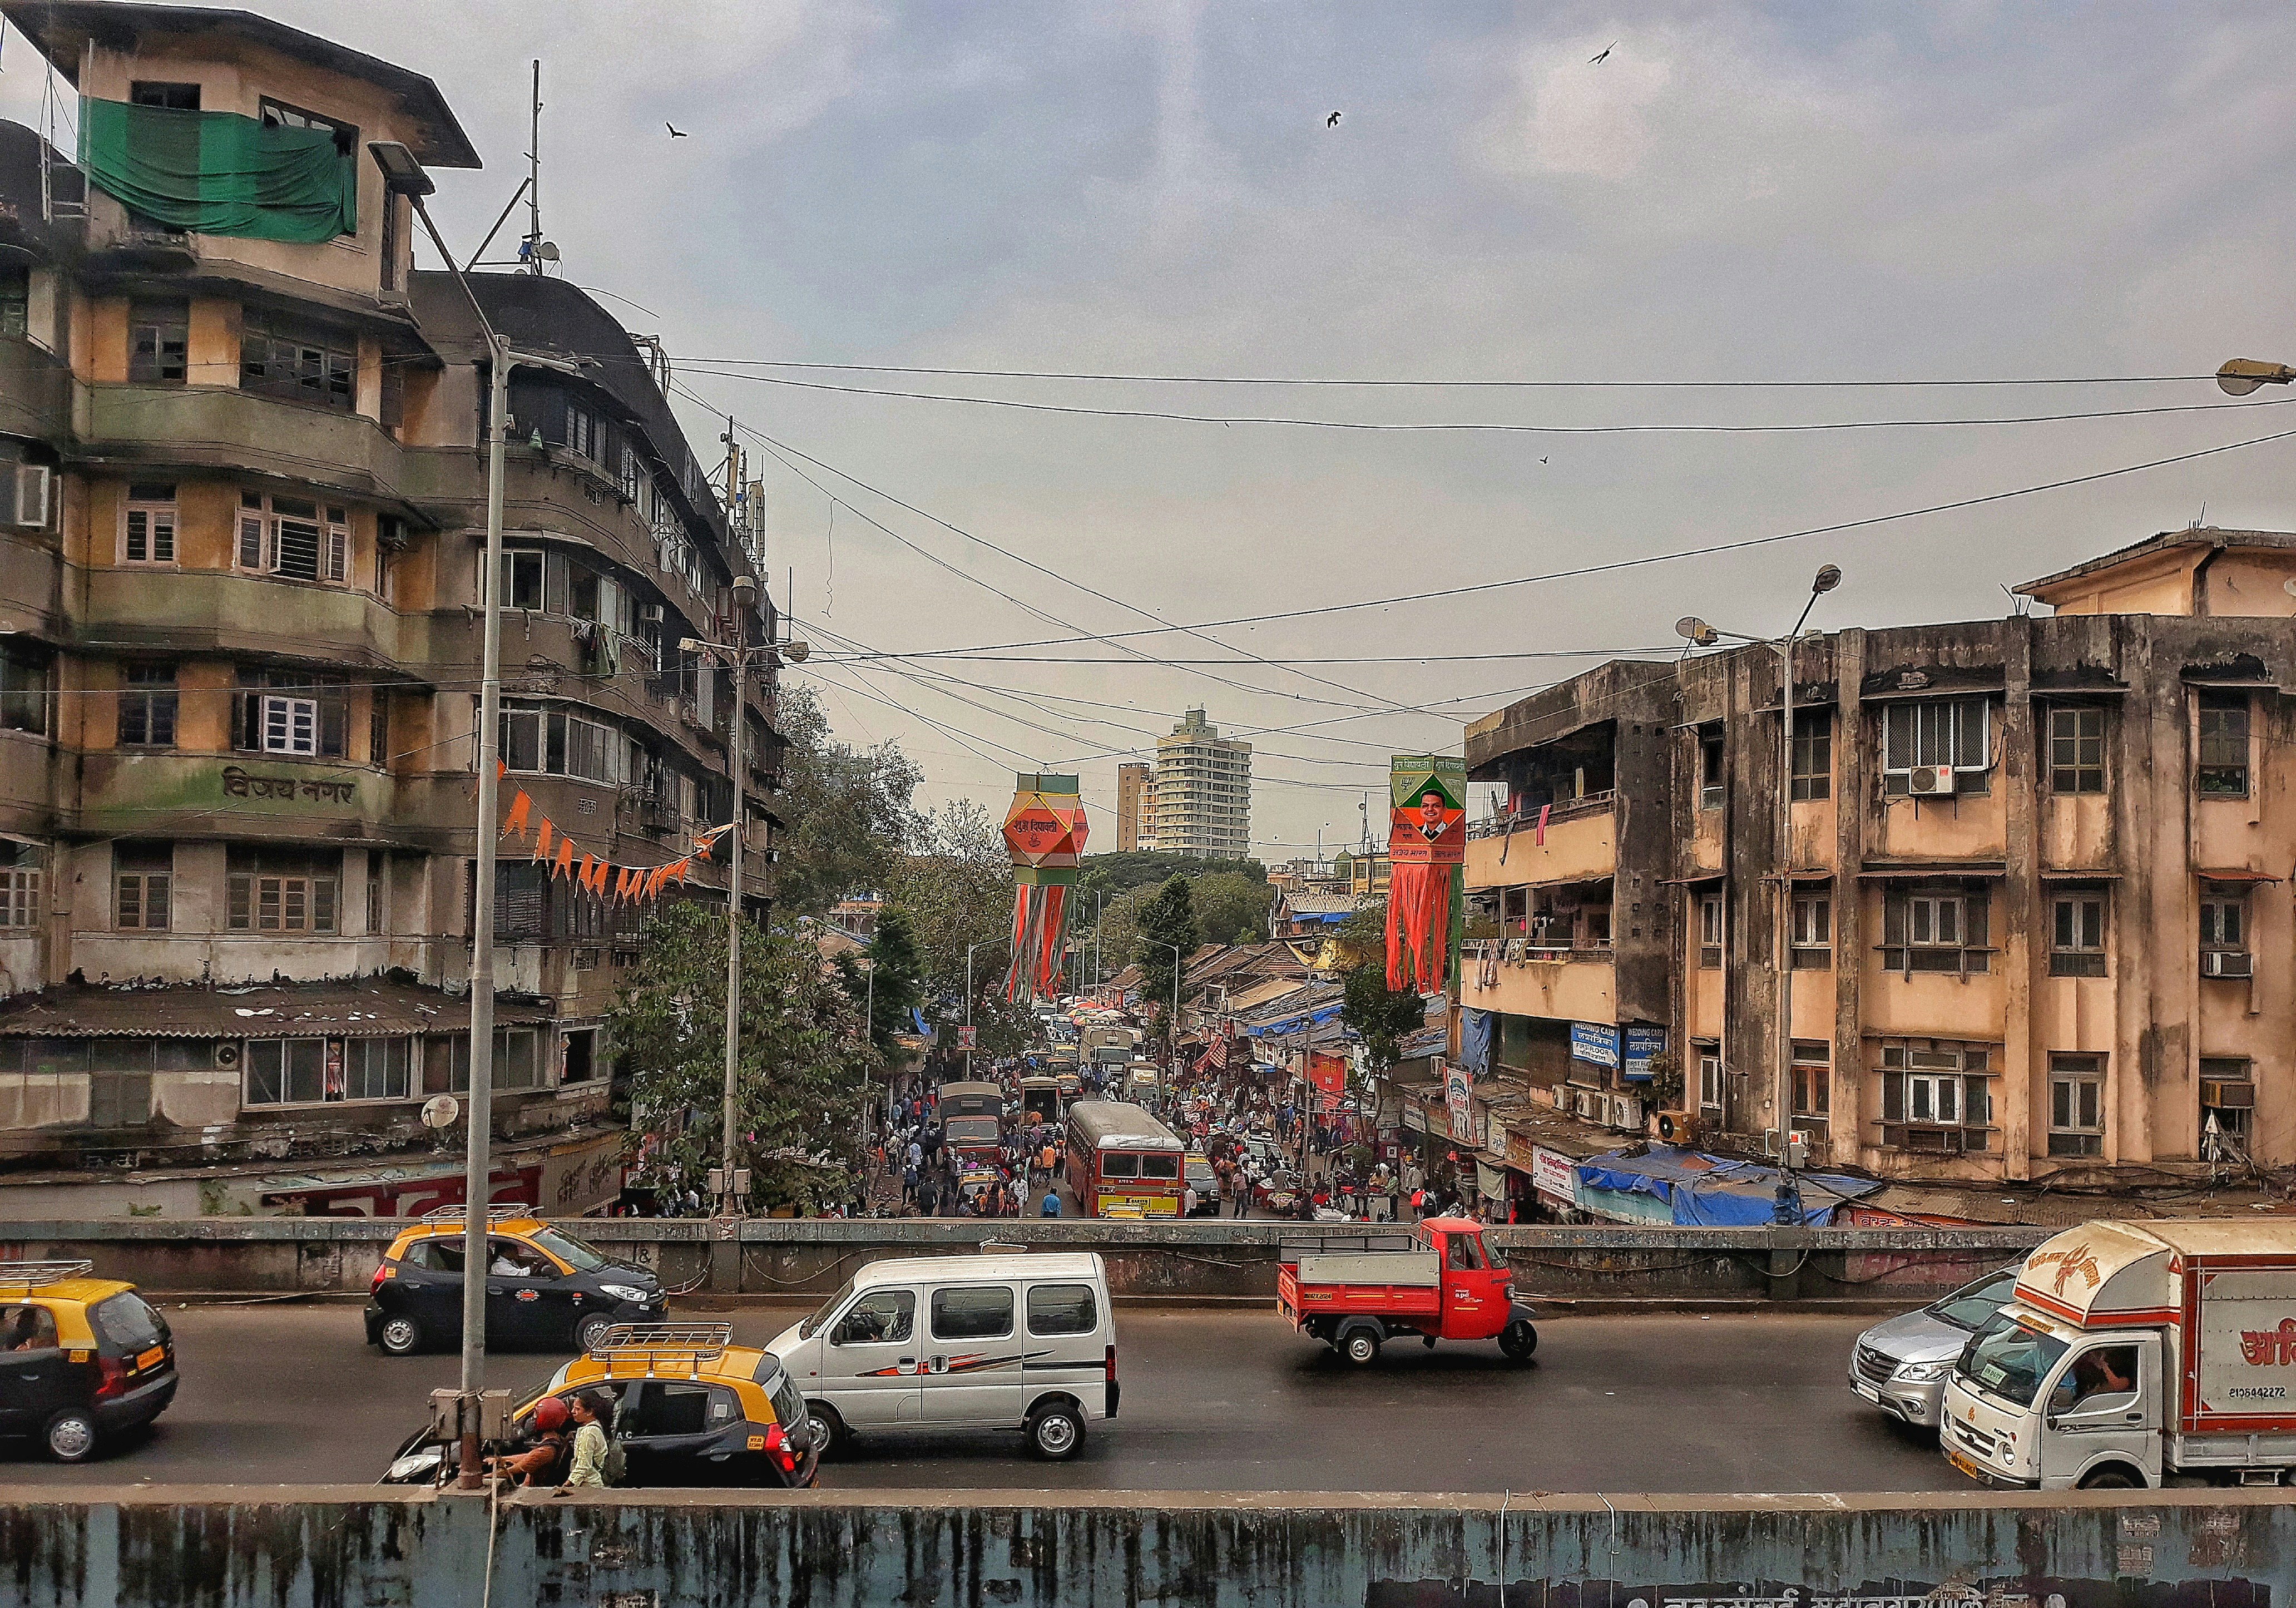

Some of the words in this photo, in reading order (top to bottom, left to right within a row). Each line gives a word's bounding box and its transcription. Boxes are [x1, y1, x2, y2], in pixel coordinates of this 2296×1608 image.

[222, 765, 296, 800] विजय
[300, 779, 356, 804] नगर
[1627, 1028, 1650, 1037] WEDDING
[1651, 1029, 1664, 1037] CARD
[1590, 1045, 1609, 1056] FLOOR
